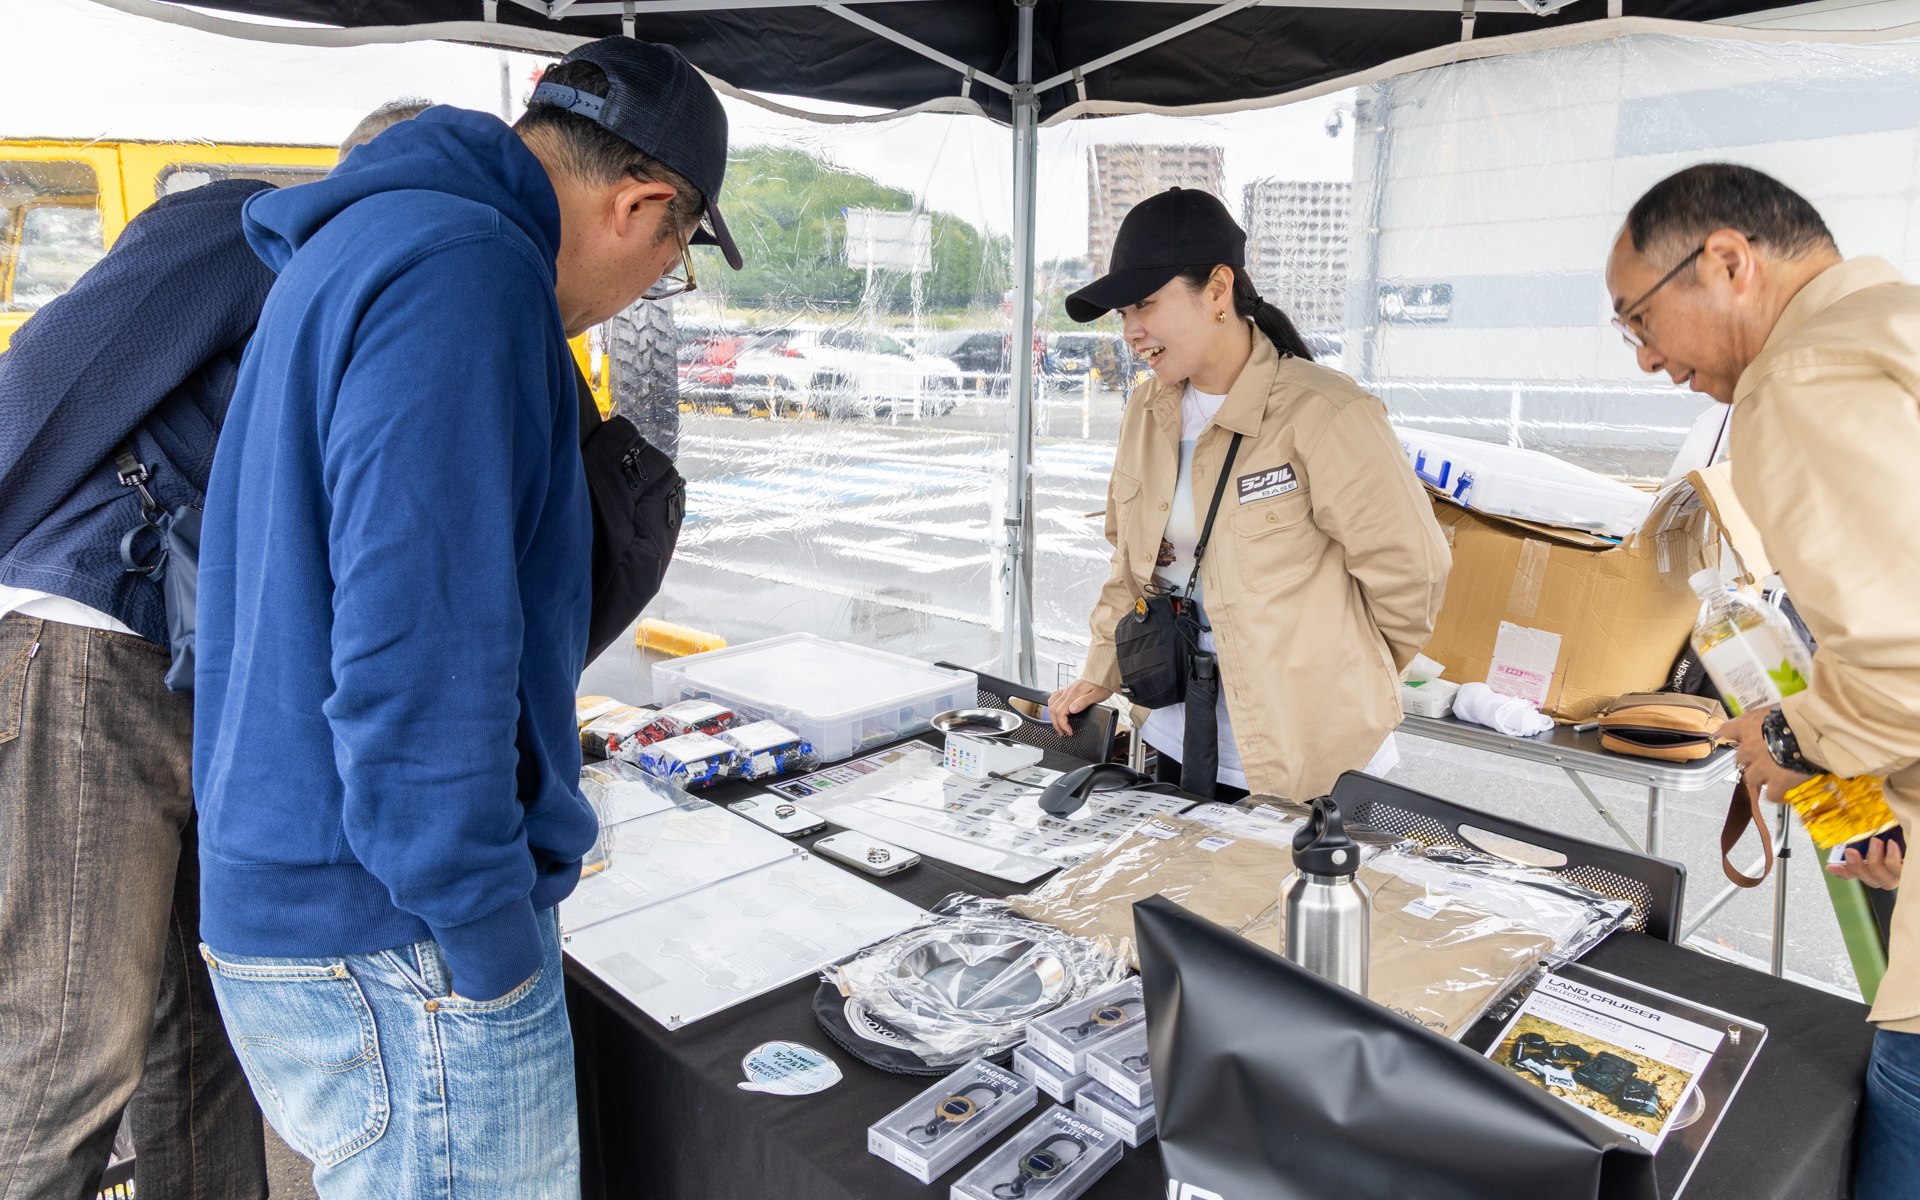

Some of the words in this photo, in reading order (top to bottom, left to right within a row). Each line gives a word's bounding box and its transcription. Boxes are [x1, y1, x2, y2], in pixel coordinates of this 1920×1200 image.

[1241, 467, 1292, 492] ランクル
[1262, 482, 1295, 497] BASE
[1673, 658, 1691, 690] MOMENT
[942, 967, 979, 983] LND
[1544, 984, 1591, 1004] COLLECTION
[1547, 978, 1589, 999] LAND
[1591, 993, 1661, 1022] CRUISER
[973, 1063, 1020, 1089] MAGREEL
[979, 1075, 1000, 1088] LITE
[1053, 1111, 1106, 1141] MAGREEL
[1061, 1125, 1085, 1140] LITE
